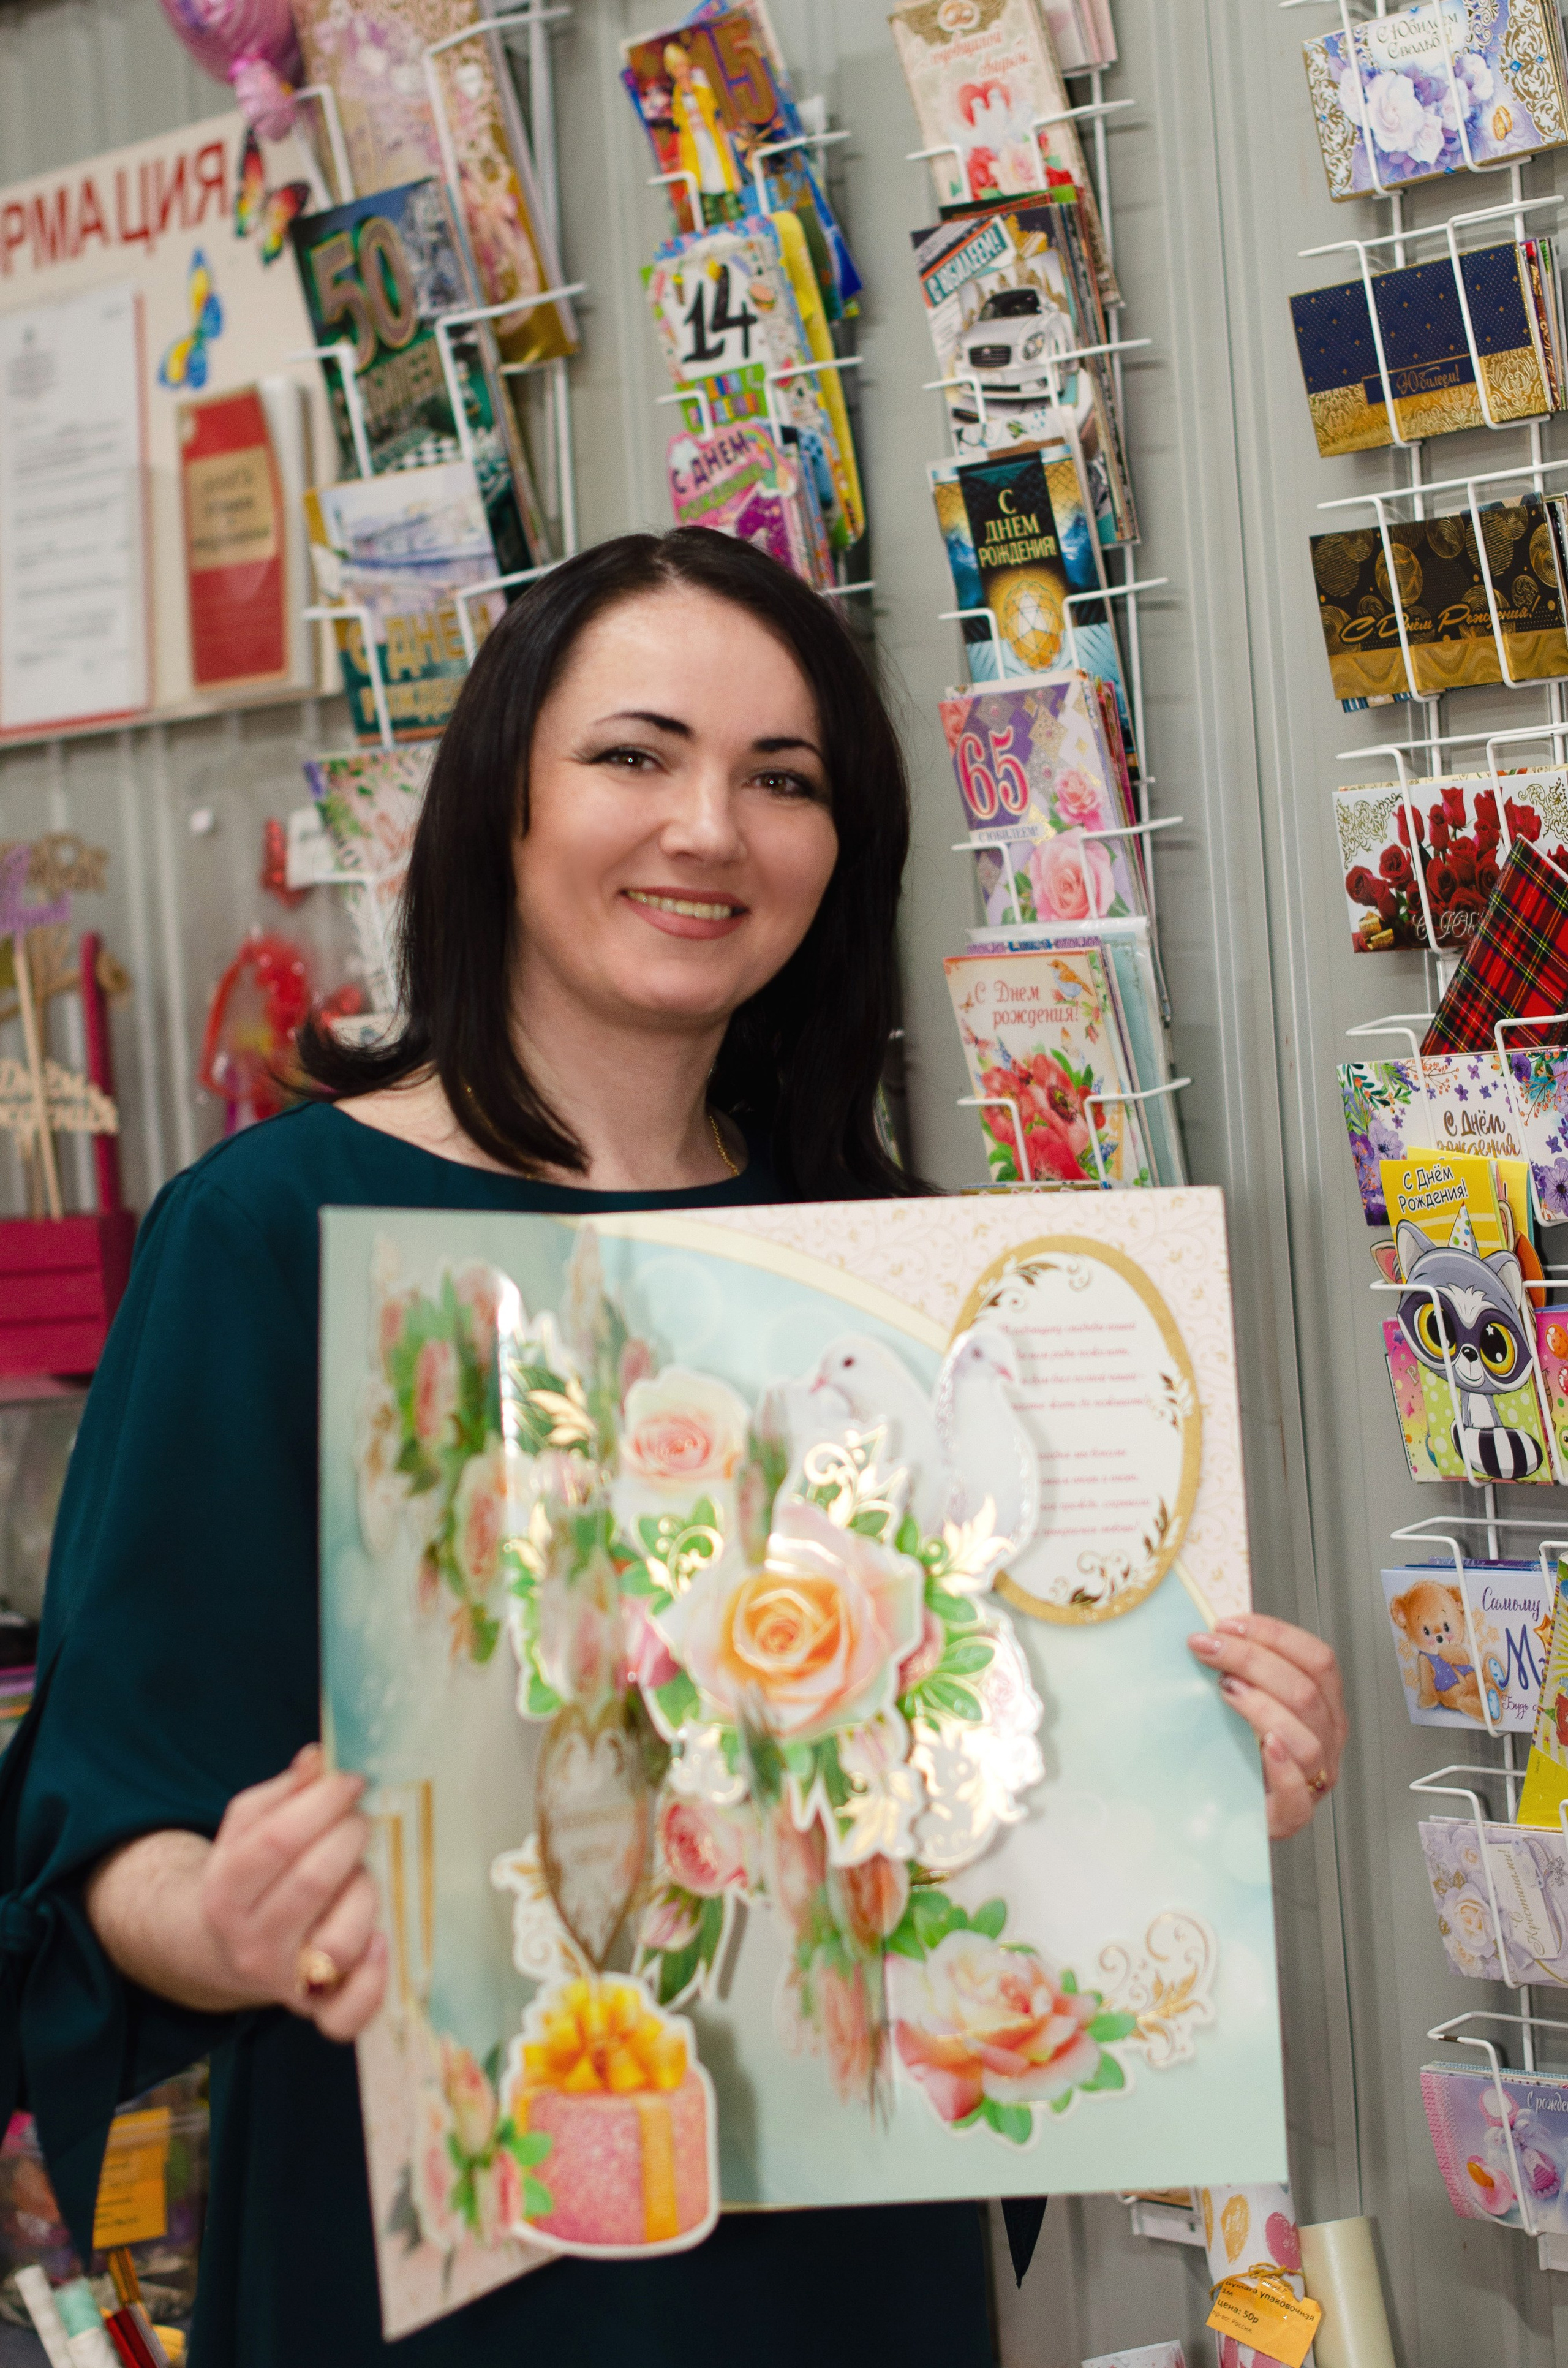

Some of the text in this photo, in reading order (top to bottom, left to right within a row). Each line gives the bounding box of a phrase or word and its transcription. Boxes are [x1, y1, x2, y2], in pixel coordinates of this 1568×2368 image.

[687, 17, 777, 131] 15
[0, 138, 232, 277] РМАЦИЯ
[311, 218, 418, 373] 50
[682, 262, 758, 363] 14
[998, 489, 1016, 514] С
[985, 513, 1041, 545] ДНЕМ
[1341, 616, 1376, 642] С
[957, 726, 1030, 820] 65
[974, 980, 1040, 1003] С Днем
[993, 999, 1079, 1030] рождения!
[1443, 1109, 1506, 1137] С Днём
[1403, 1164, 1454, 1190] С Днём
[1397, 1178, 1469, 1213] Рождения!
[1482, 1586, 1540, 1622] Самому
[1502, 1695, 1529, 1720] Будь
[1527, 2090, 1533, 2108] С
[1217, 2299, 1259, 2324] цена: 50р
[1259, 2291, 1314, 2321] упаковочная
